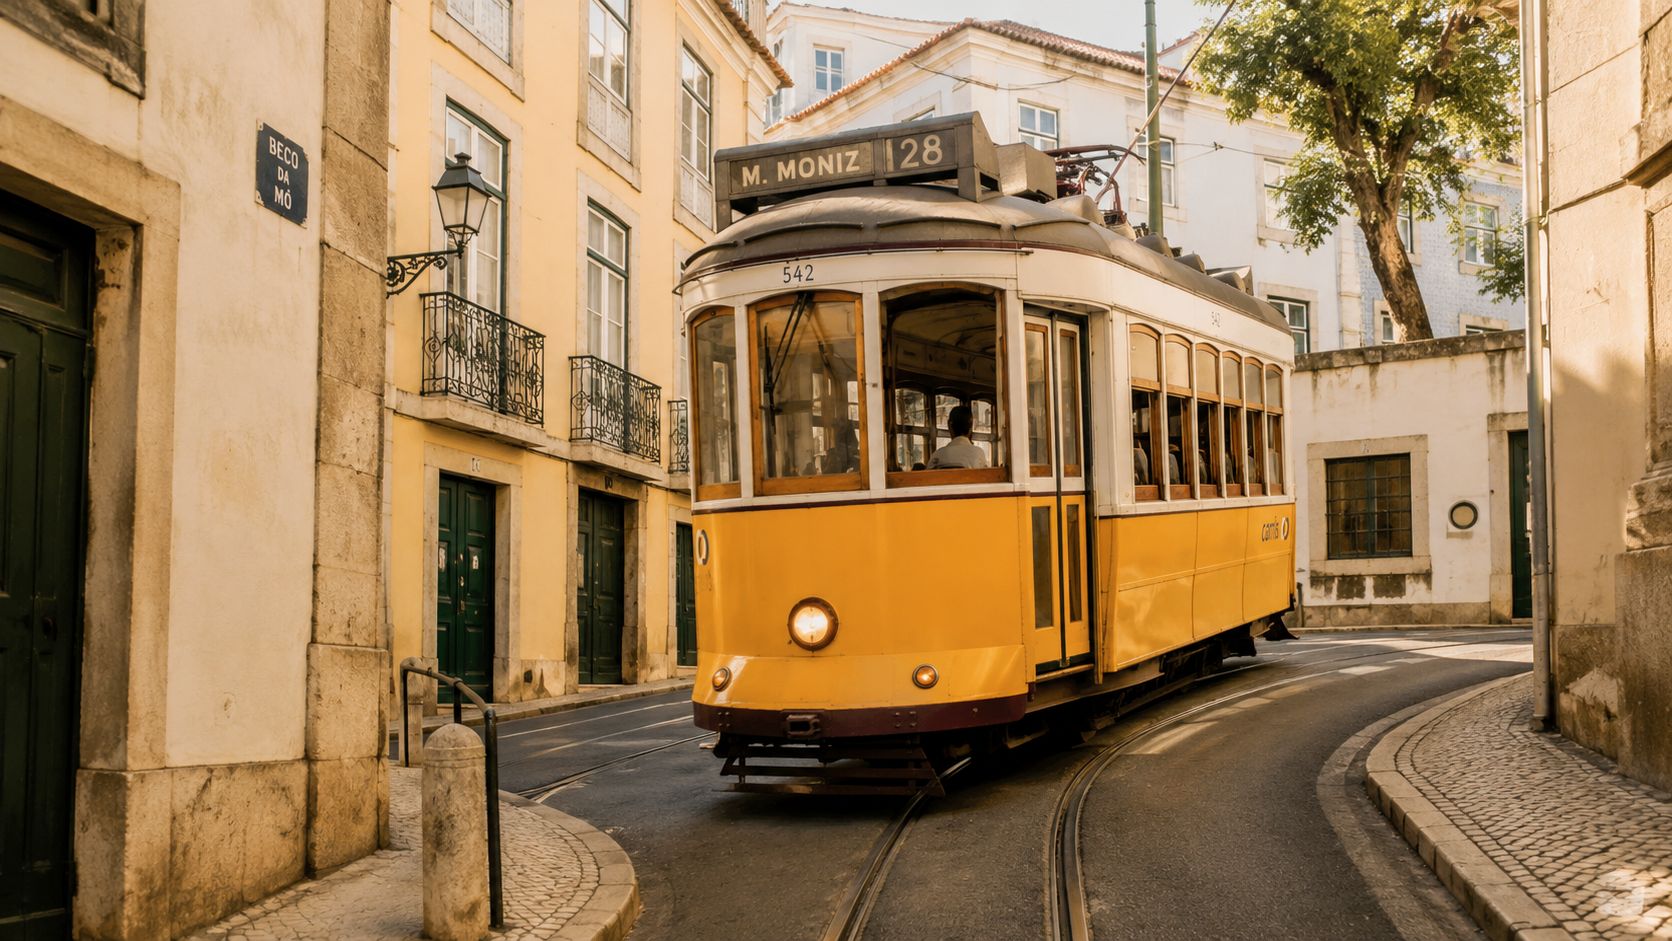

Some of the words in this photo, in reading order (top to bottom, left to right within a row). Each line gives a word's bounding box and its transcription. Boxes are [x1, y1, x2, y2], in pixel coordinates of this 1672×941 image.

[269, 136, 299, 170] BECO
[277, 166, 290, 186] DA
[742, 165, 768, 187] M.
[777, 150, 860, 182] MONIZ
[783, 264, 814, 284] 542
